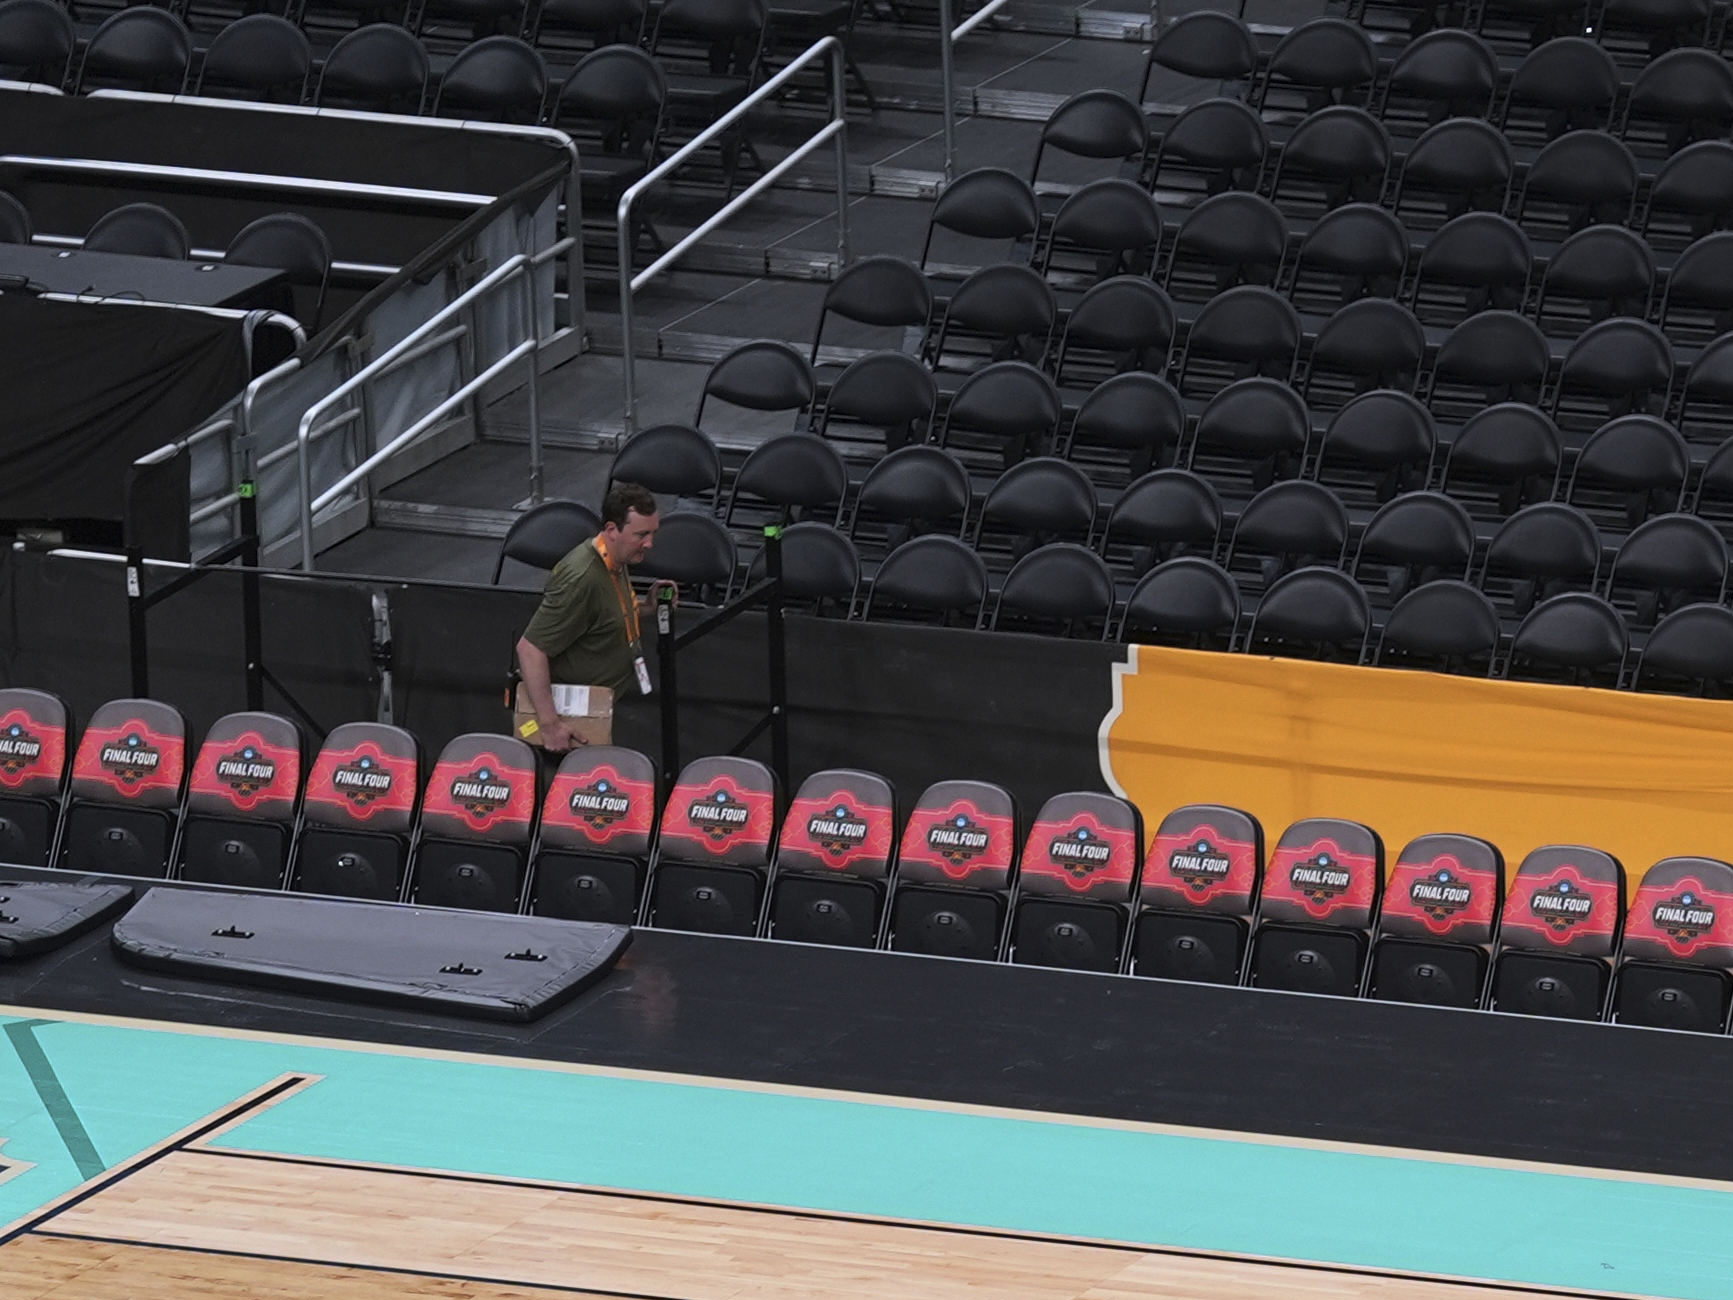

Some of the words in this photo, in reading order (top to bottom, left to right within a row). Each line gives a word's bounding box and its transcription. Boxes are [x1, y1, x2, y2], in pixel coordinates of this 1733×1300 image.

[13, 742, 39, 756] FOUR
[104, 749, 131, 763] FINAL
[129, 752, 157, 765] FOUR
[219, 762, 247, 776] FINAL
[245, 765, 273, 777] FOUR
[336, 771, 364, 785] FINAL
[362, 774, 390, 787] FOUR
[454, 783, 482, 797] FINAL
[480, 786, 508, 799] FOUR
[573, 795, 601, 809] FINAL
[599, 798, 627, 811] FOUR
[691, 806, 719, 820] FINAL
[717, 809, 746, 821] FOUR
[810, 820, 838, 834] FINAL
[836, 823, 865, 836] FOUR
[931, 830, 959, 844] FINAL
[957, 833, 986, 846] FOUR
[1053, 843, 1081, 857] FINAL
[1079, 846, 1108, 859] FOUR
[1172, 856, 1201, 870] FINAL
[1199, 859, 1228, 872] FOUR
[1293, 869, 1321, 883] FINAL
[1319, 872, 1348, 885] FOUR
[1413, 885, 1442, 899] FINAL
[1440, 888, 1469, 901] FOUR
[1534, 896, 1563, 910] FINAL
[1561, 899, 1590, 912] FOUR
[1656, 908, 1685, 922] FINAL
[1683, 911, 1713, 924] FOUR
